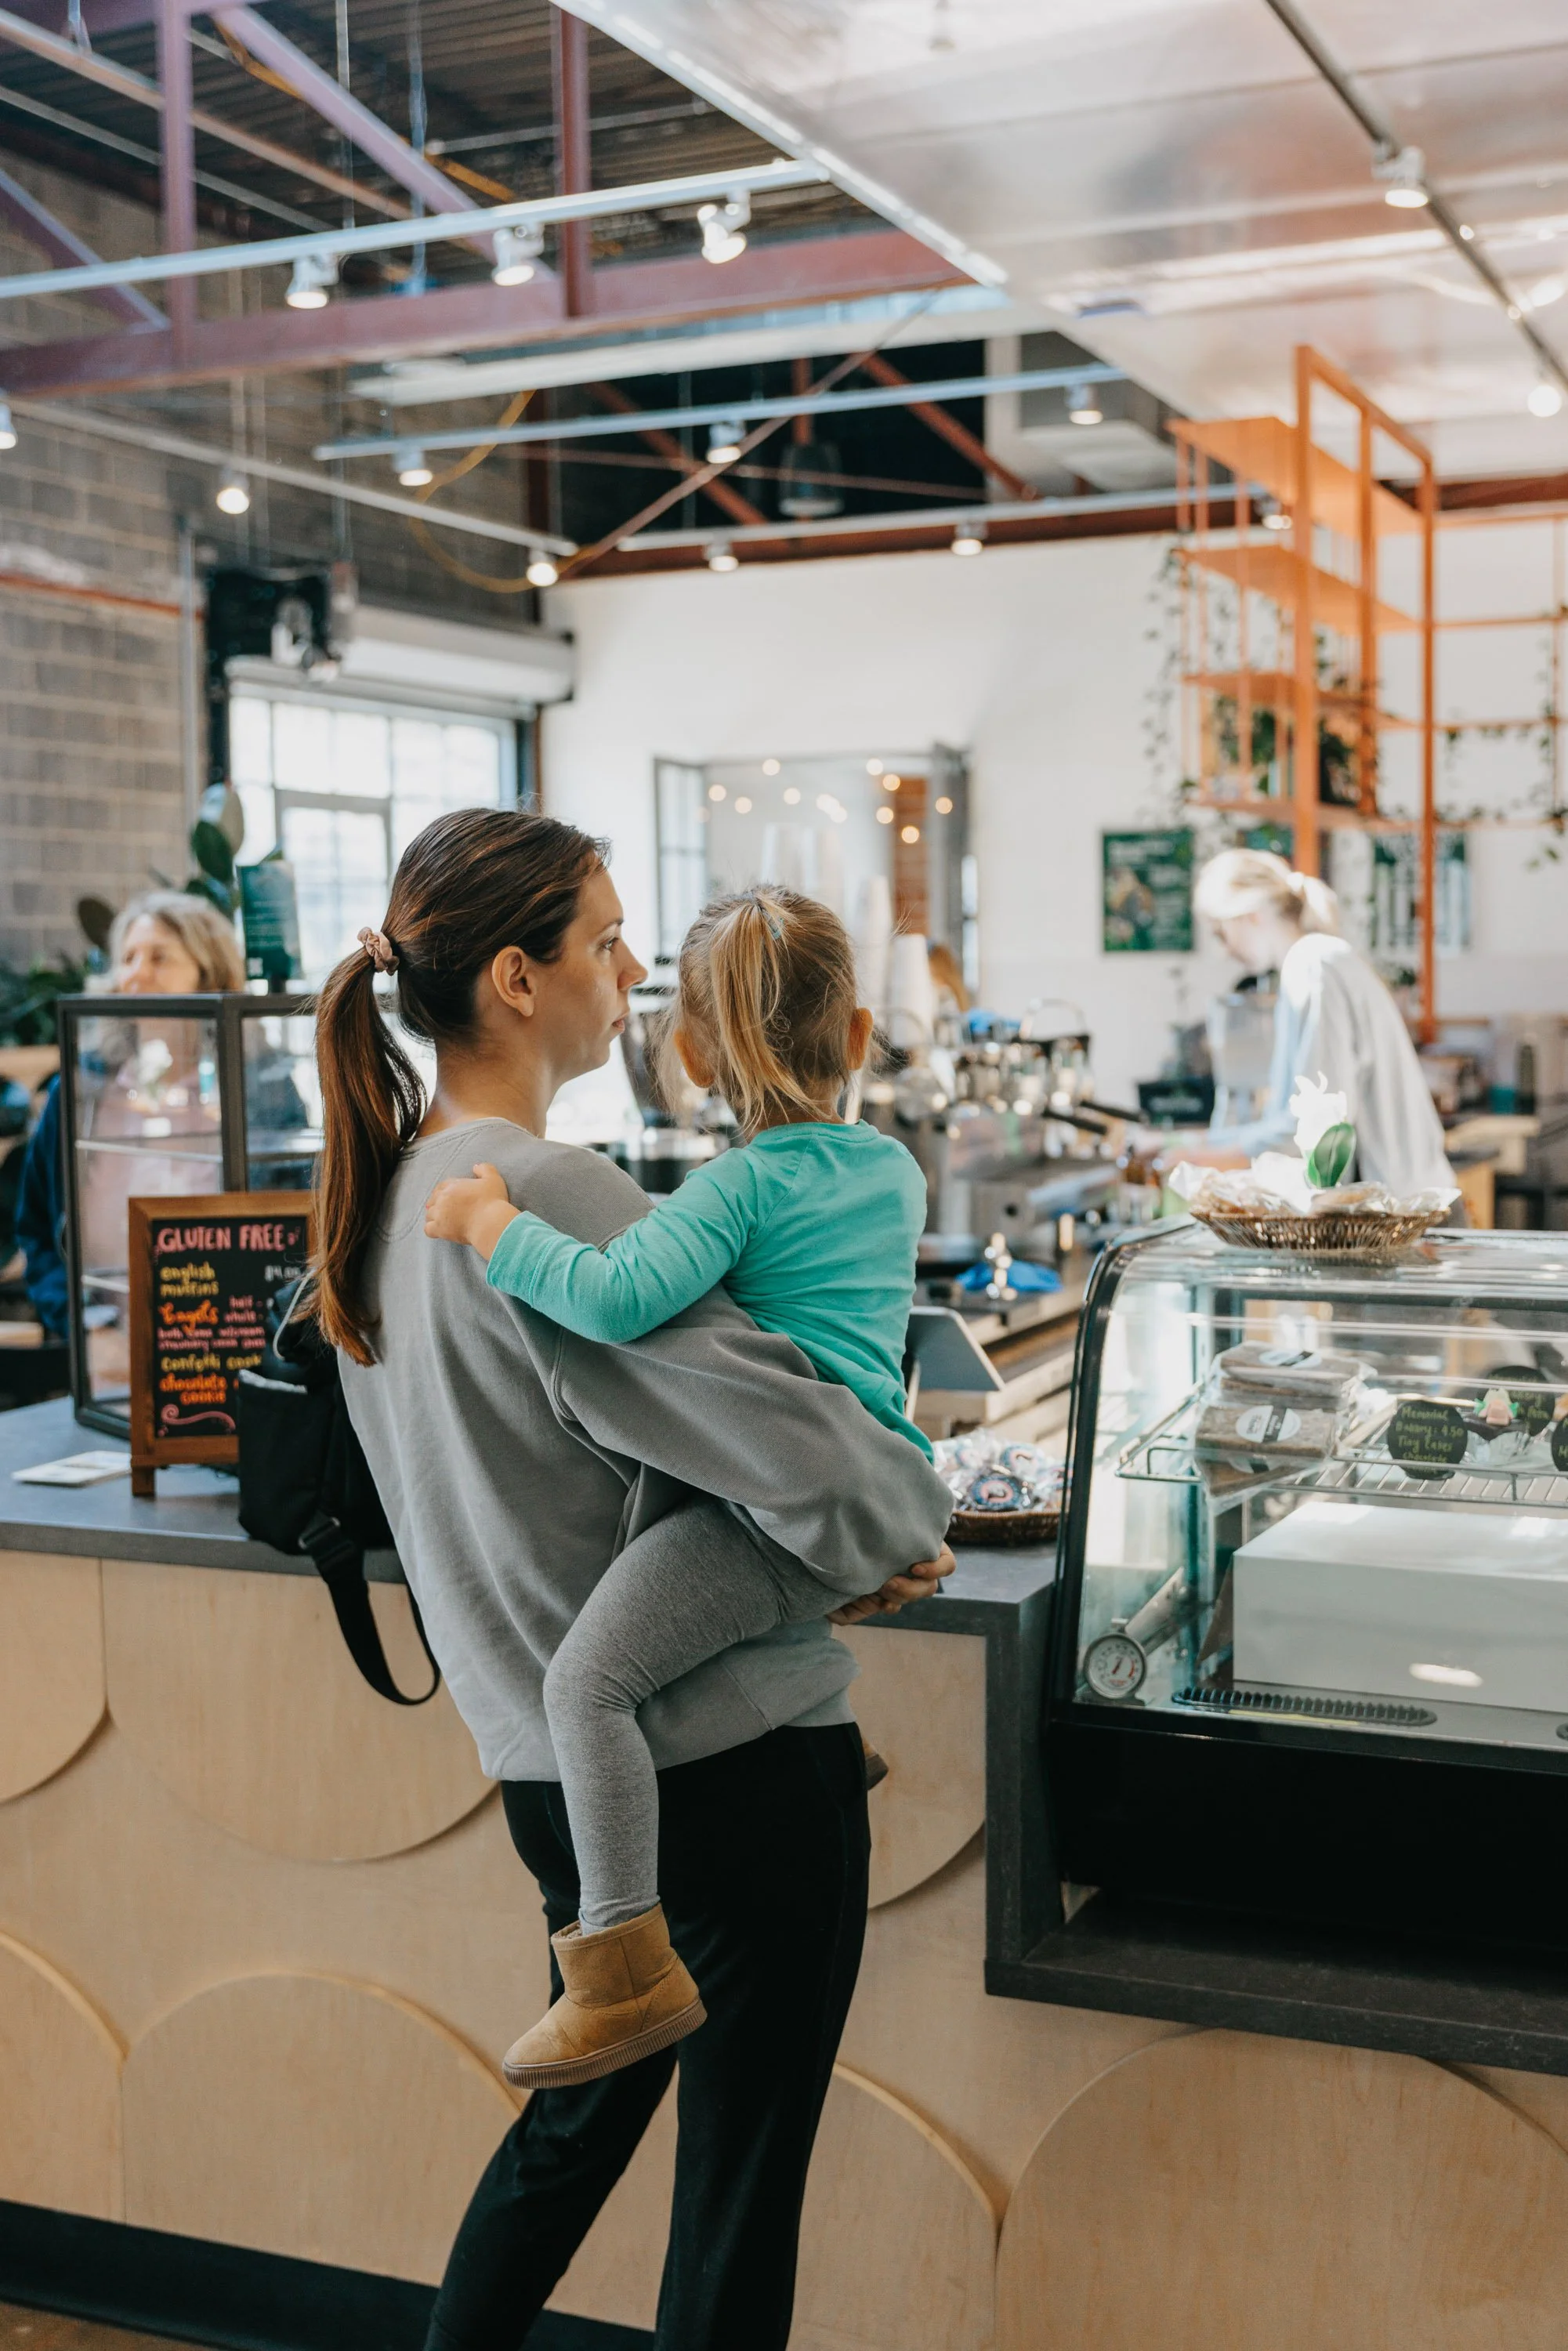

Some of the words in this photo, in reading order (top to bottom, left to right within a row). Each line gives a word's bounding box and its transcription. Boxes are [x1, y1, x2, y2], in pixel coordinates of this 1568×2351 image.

[158, 1226, 231, 1252] GLUTEN
[239, 1223, 285, 1252] FREE
[160, 1261, 215, 1284] english
[160, 1280, 219, 1298] muffins
[226, 1353, 262, 1370] cook
[160, 1372, 227, 1392] chocolate
